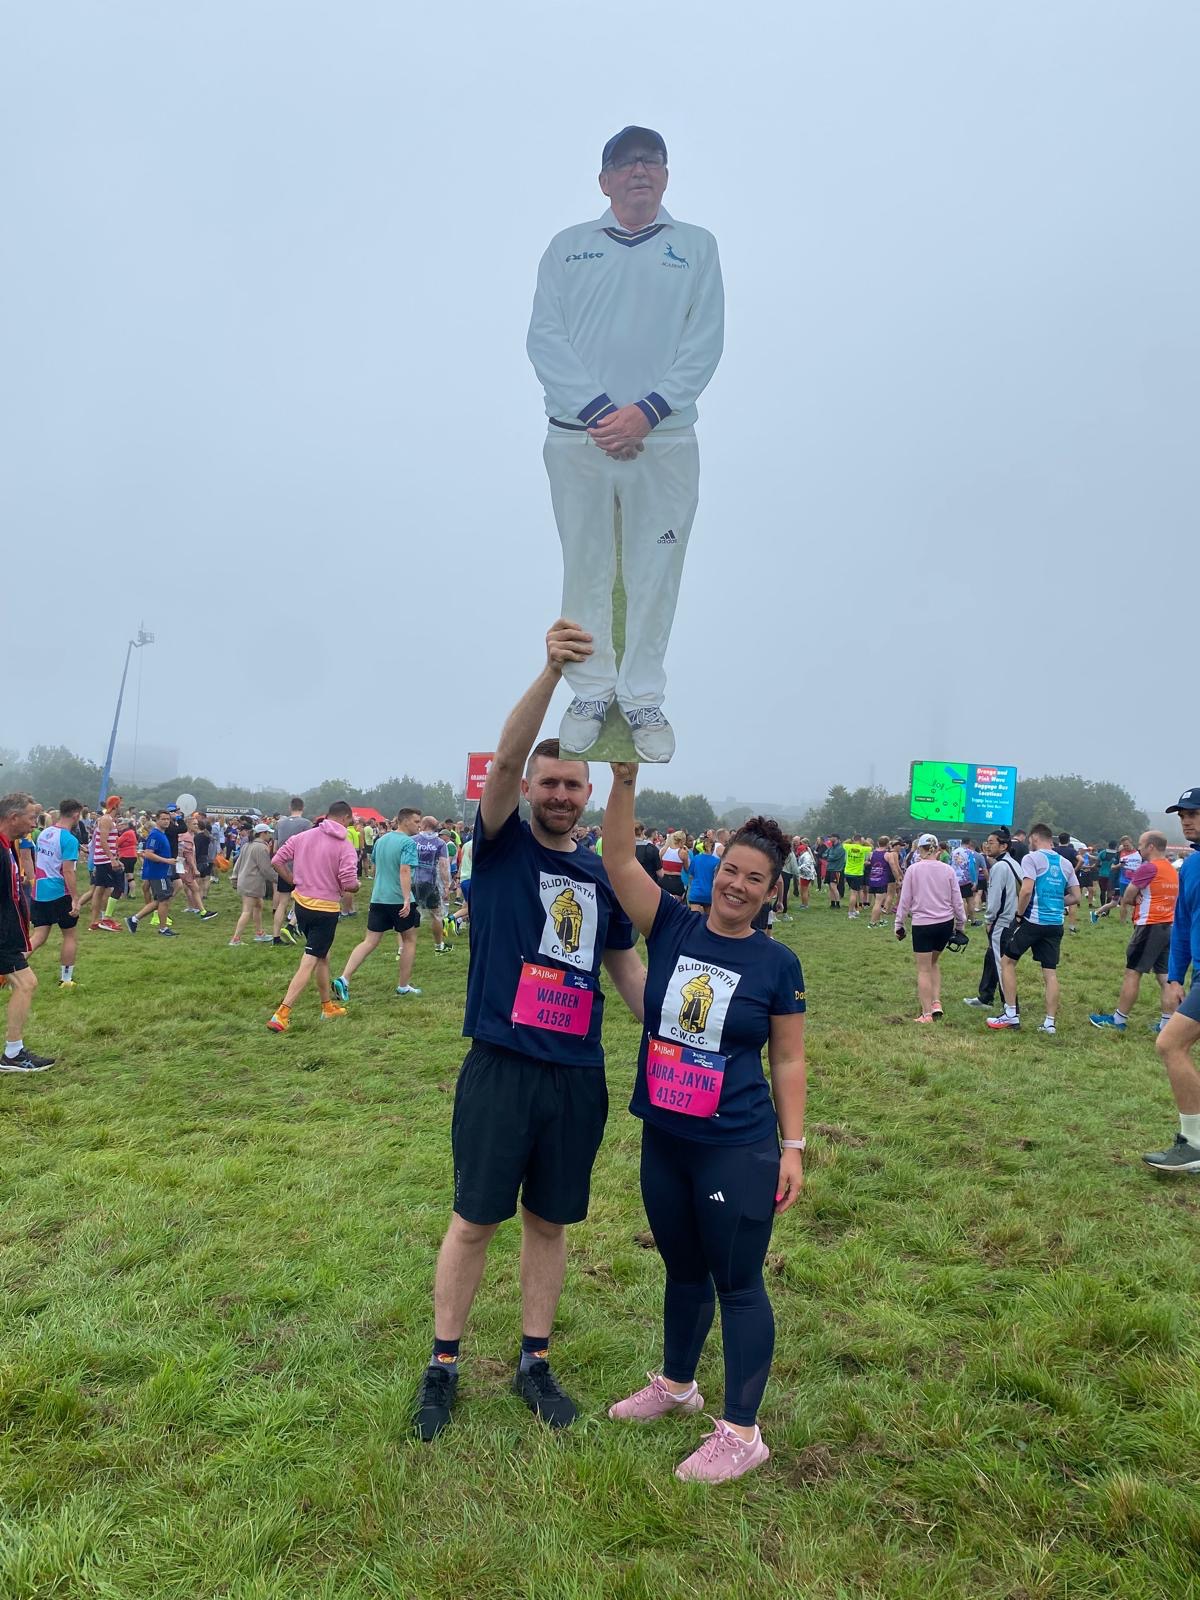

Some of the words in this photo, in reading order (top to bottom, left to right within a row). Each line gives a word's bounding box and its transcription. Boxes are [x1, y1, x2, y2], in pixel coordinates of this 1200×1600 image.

[416, 842, 438, 851] troke
[540, 878, 595, 900] BLIDWORTH
[677, 963, 736, 988] BLIDWORTH
[537, 986, 580, 1009] WARREN
[537, 1008, 572, 1028] 41528
[670, 1026, 708, 1045] C.W.C.C.
[648, 1062, 717, 1093] LAURA-JAYNE
[656, 1086, 693, 1109] 41527
